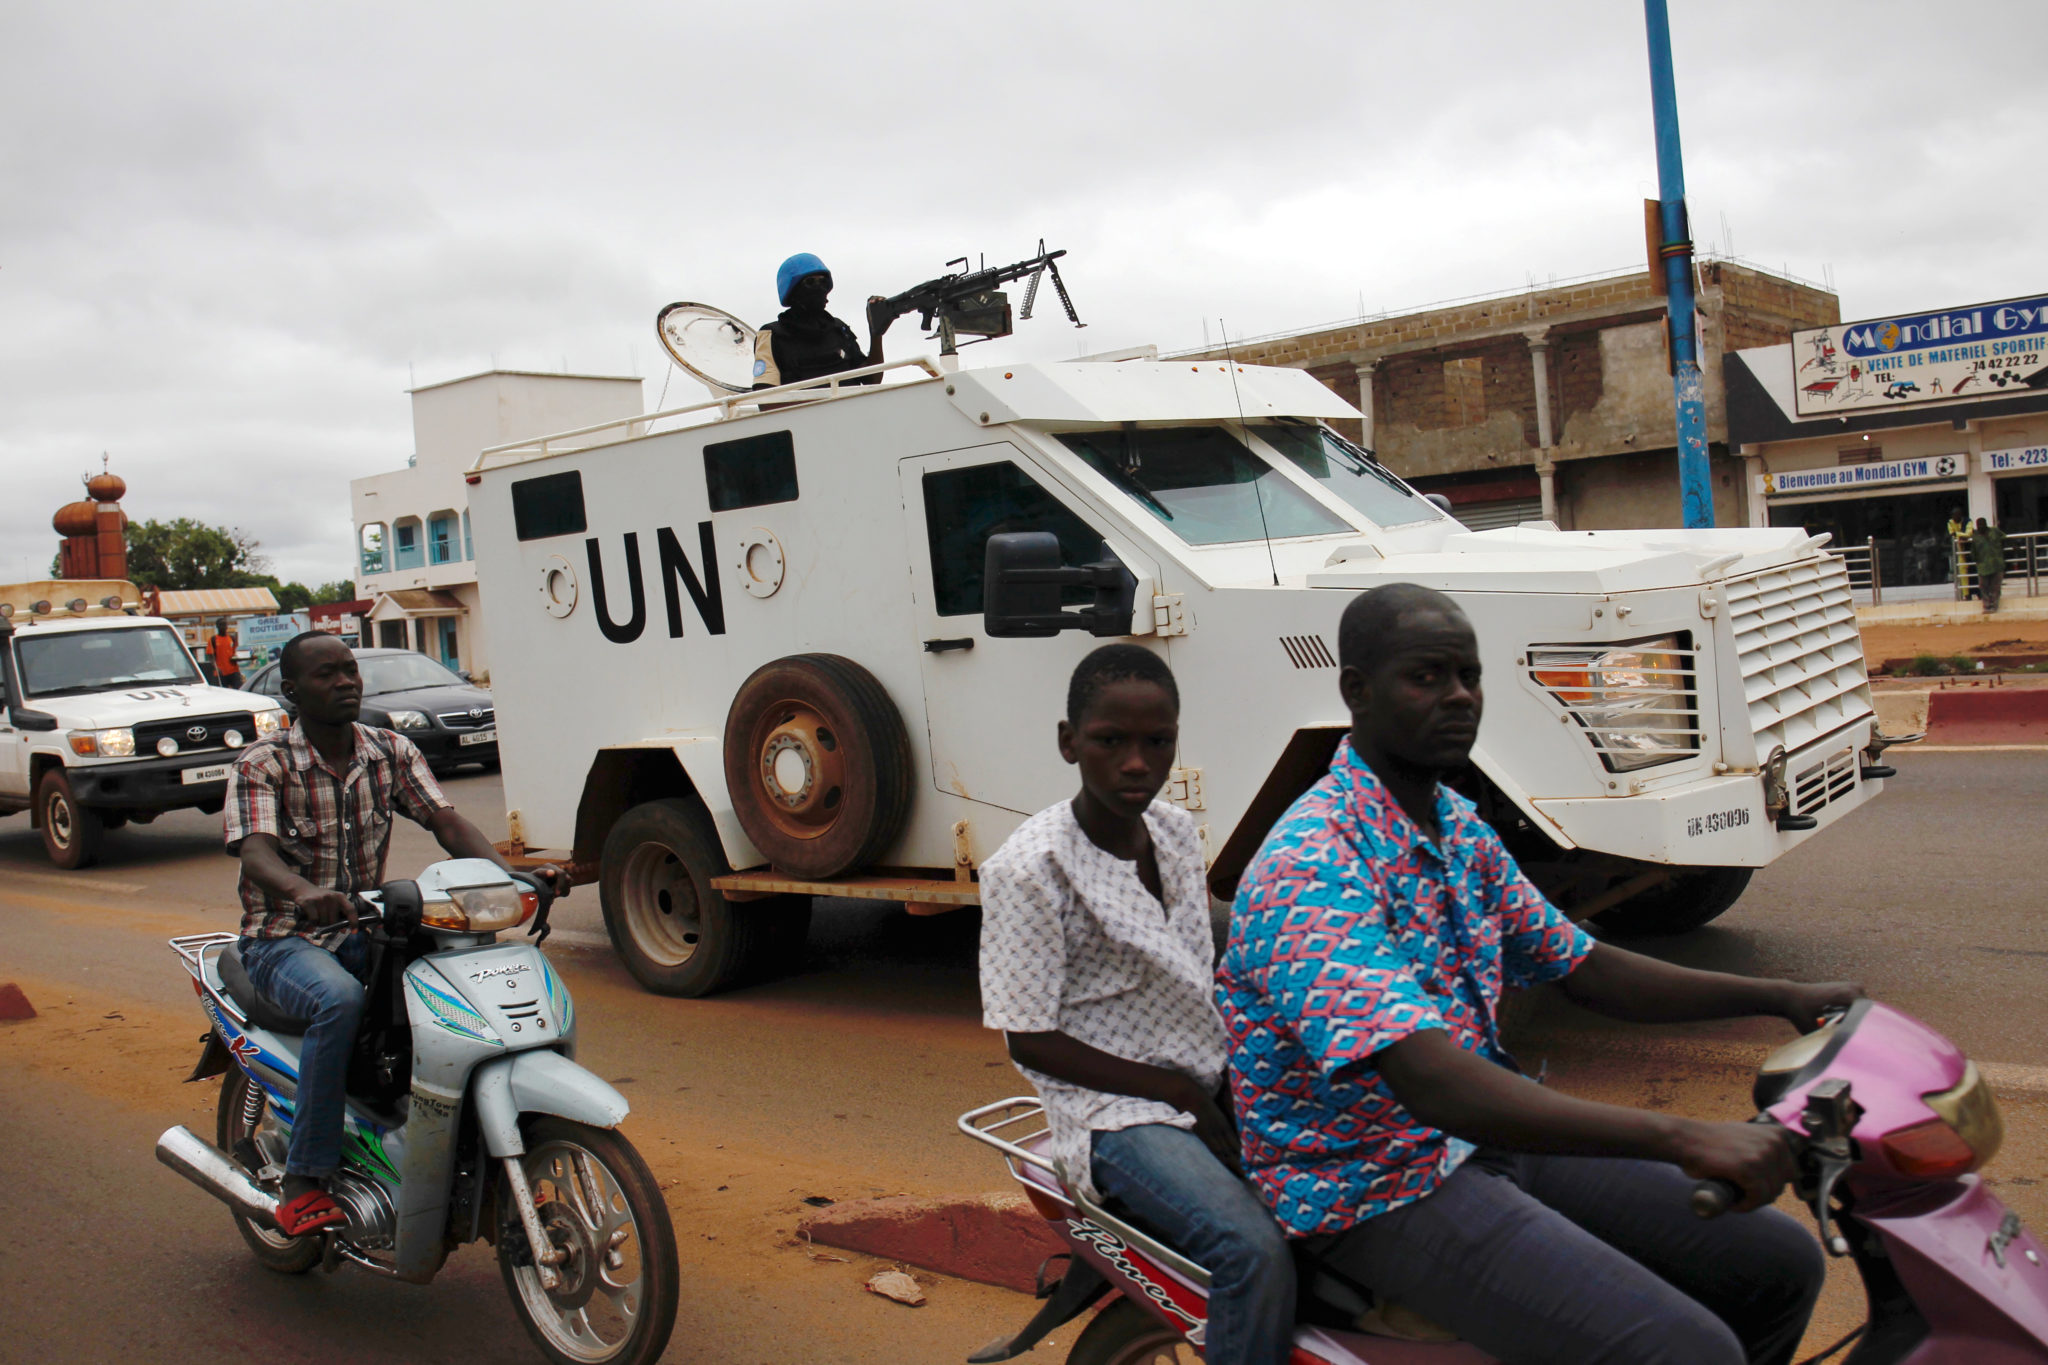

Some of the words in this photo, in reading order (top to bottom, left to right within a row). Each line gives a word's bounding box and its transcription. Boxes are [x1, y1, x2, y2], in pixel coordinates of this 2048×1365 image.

[1846, 311, 1982, 352] Mondial
[1868, 356, 1904, 372] VENTE
[1908, 353, 1924, 367] DE
[1928, 345, 1988, 364] MATERIEL
[1992, 337, 2046, 356] SPORTIF
[1875, 373, 1896, 384] TEL:
[1972, 360, 1986, 371] 74
[1988, 358, 2003, 369] 42
[2005, 356, 2020, 367] 22
[2023, 354, 2038, 365] 22
[1991, 453, 2014, 468] Tel:
[2018, 448, 2048, 465] +223
[1779, 473, 1837, 489] Bienvenue
[1839, 470, 1853, 483] au
[1855, 464, 1901, 481] Mondial
[1903, 461, 1928, 476] GYM
[585, 520, 726, 644] UN
[126, 689, 185, 701] UN
